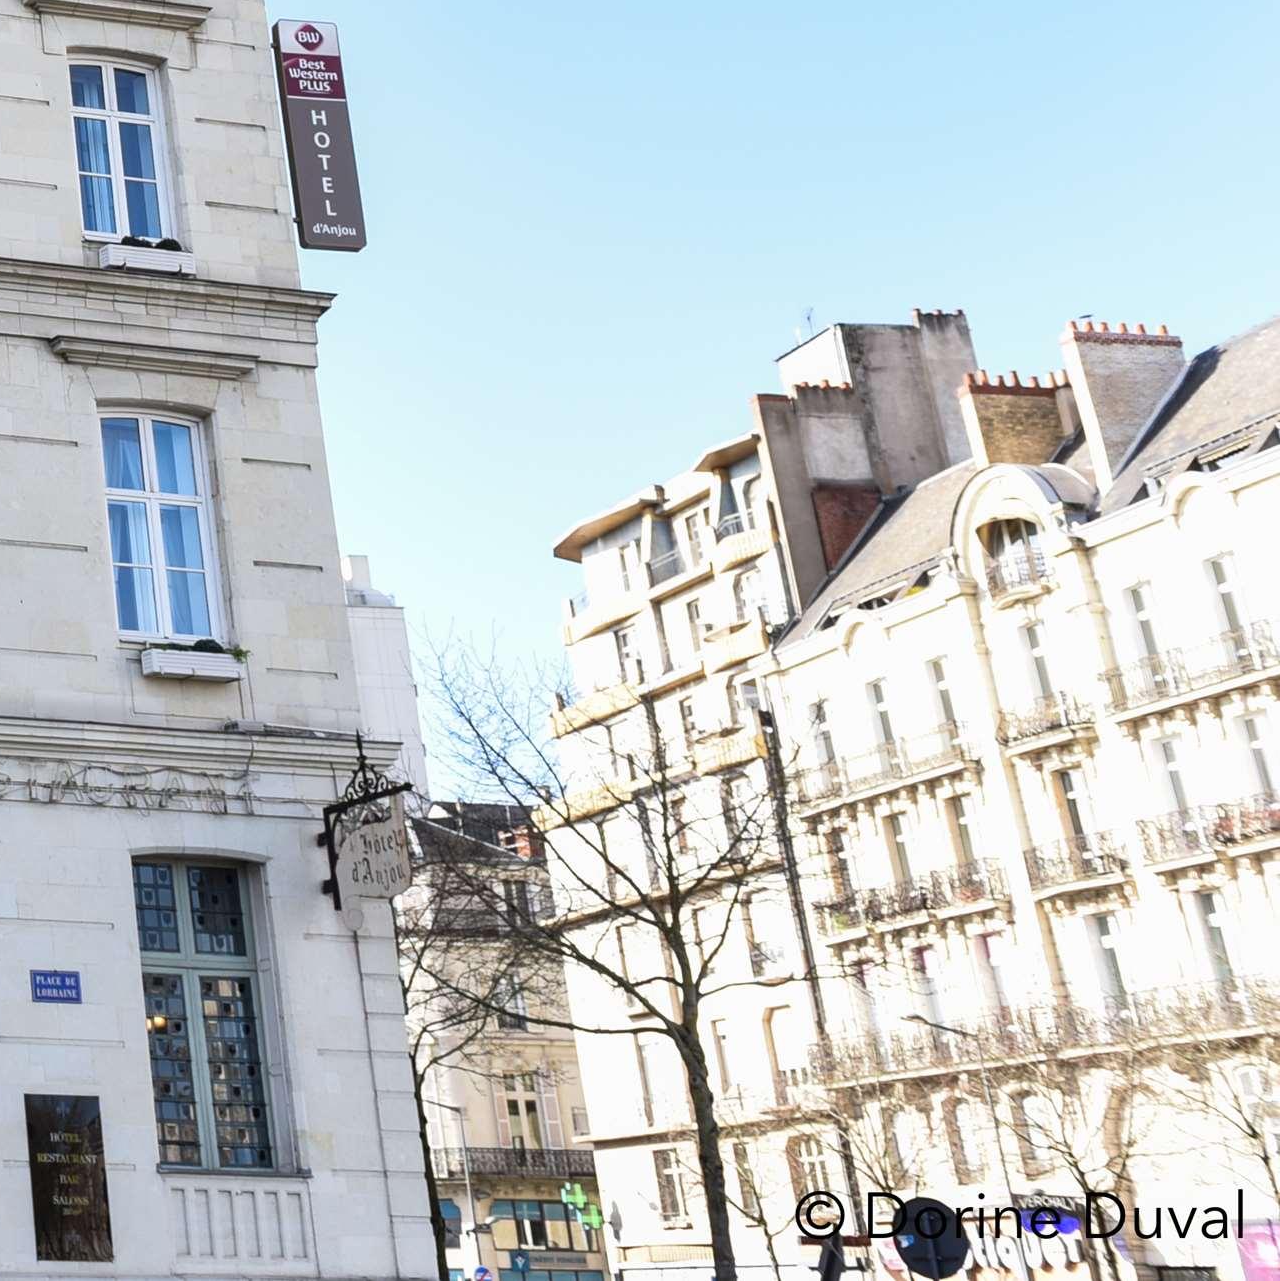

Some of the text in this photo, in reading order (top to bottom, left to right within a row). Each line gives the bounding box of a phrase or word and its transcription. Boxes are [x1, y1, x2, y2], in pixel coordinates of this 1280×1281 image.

[299, 58, 326, 71] Best
[288, 67, 339, 82] Western
[299, 80, 331, 92] PLUS
[311, 109, 337, 217] HOTEL
[312, 223, 357, 238] d'Anjou
[35, 975, 61, 986] PLACE
[36, 987, 78, 998] LORRAINE
[36, 1153, 98, 1165] RESTAURANT
